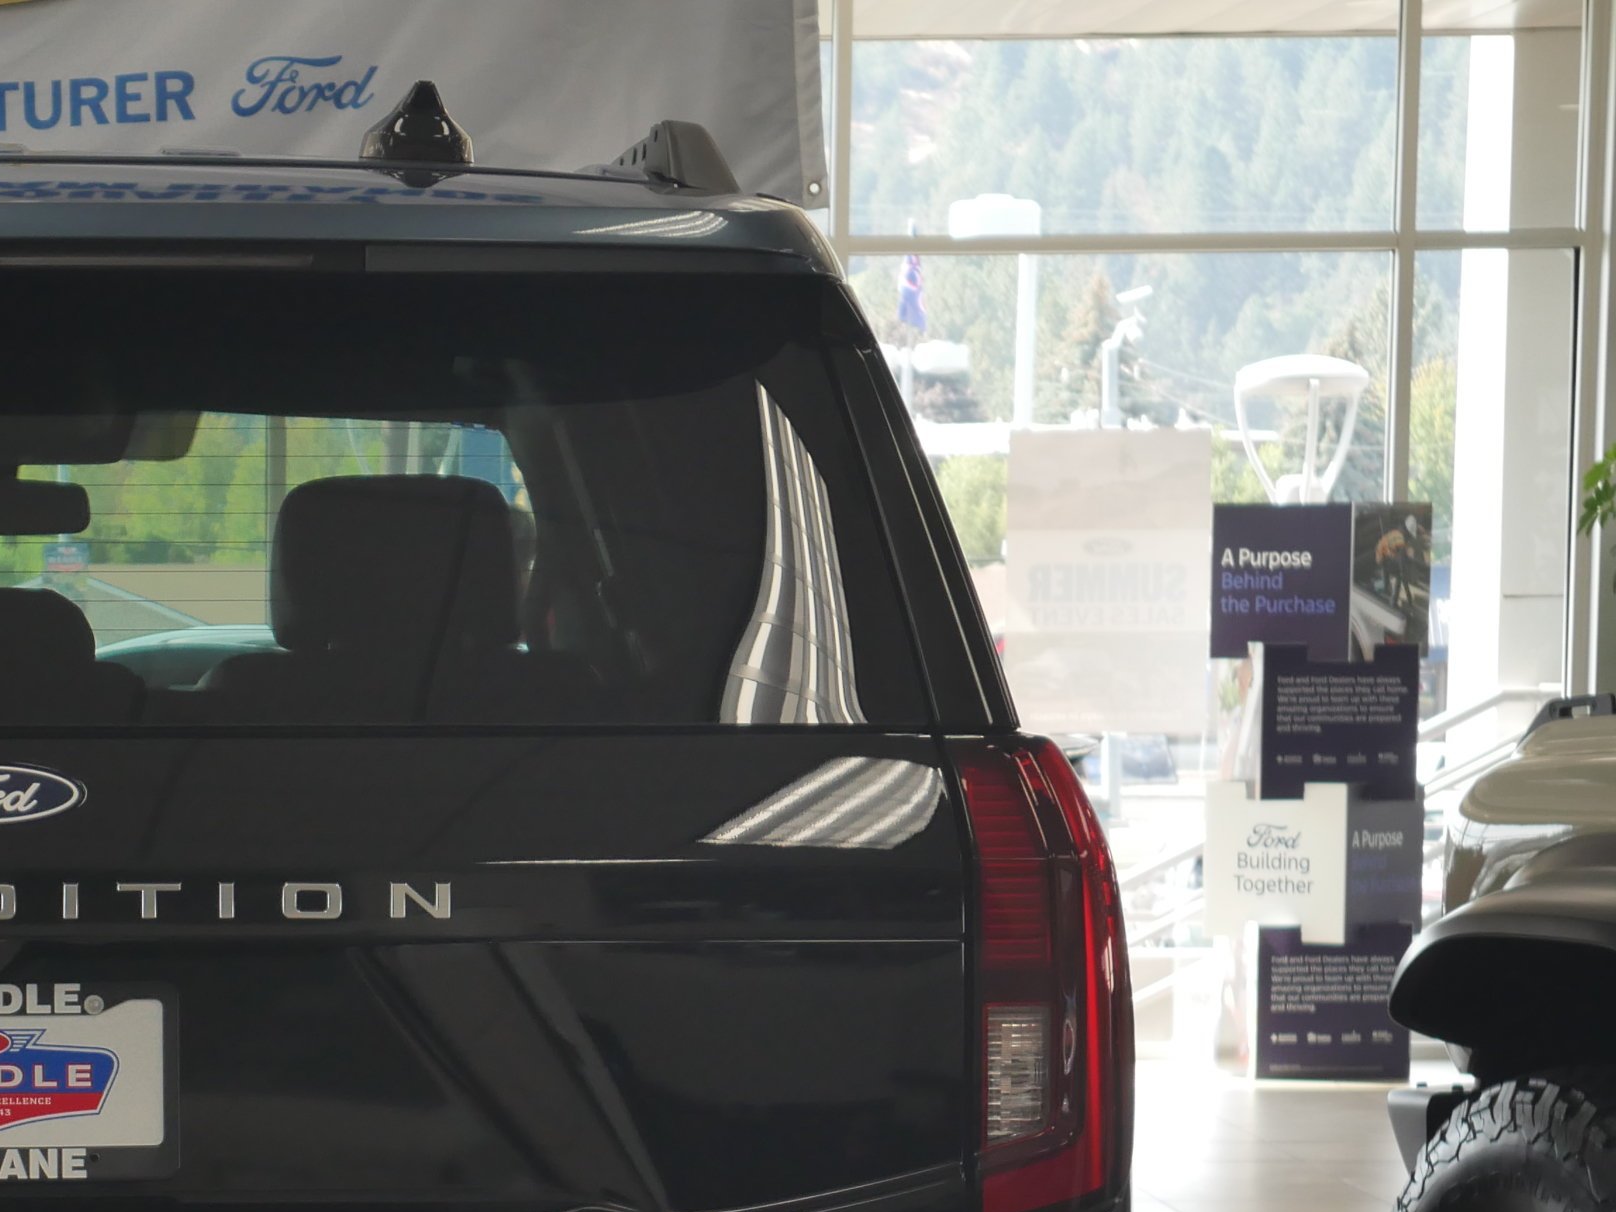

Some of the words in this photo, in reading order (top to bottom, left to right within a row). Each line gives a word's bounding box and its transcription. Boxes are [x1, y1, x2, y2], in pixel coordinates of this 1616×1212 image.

[231, 55, 378, 117] Ford
[1221, 547, 1234, 568] A
[1239, 547, 1312, 571] Purpose
[1222, 571, 1283, 589] Behind
[1221, 595, 1250, 613] the
[1255, 595, 1335, 614] Purchase
[1247, 823, 1301, 849] Ford
[1352, 831, 1360, 848] A
[1362, 830, 1403, 850] Purpose
[1237, 852, 1310, 873] Building
[1234, 875, 1313, 896] Together
